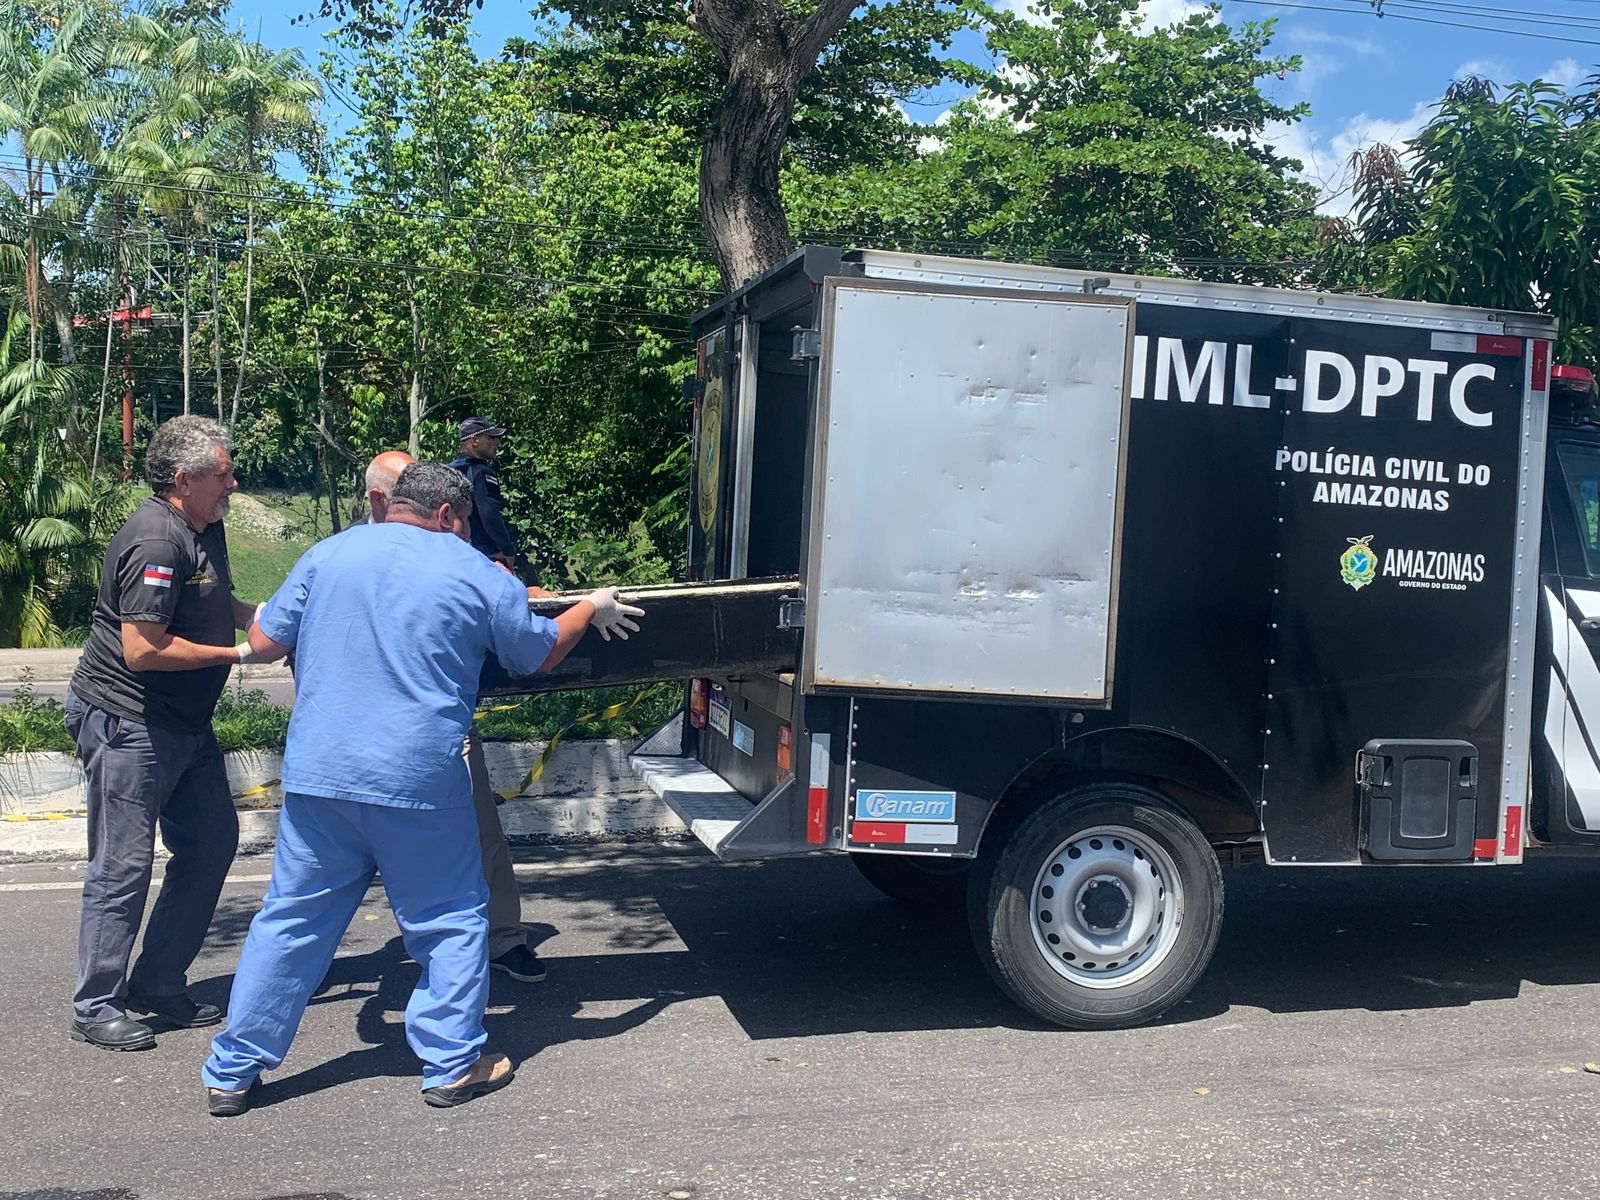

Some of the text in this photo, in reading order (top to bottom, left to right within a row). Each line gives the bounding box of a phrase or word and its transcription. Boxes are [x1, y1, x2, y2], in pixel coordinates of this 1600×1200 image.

[1131, 336, 1496, 427] IML-DPTC
[1275, 446, 1491, 486] POLÍCIA CIVIL DO
[1312, 481, 1450, 512] AMAZONAS
[1383, 548, 1485, 582] AMAZONAS
[1398, 580, 1430, 589] GOVERNO
[1441, 583, 1467, 591] ESTADO
[865, 793, 947, 818] Ranam
